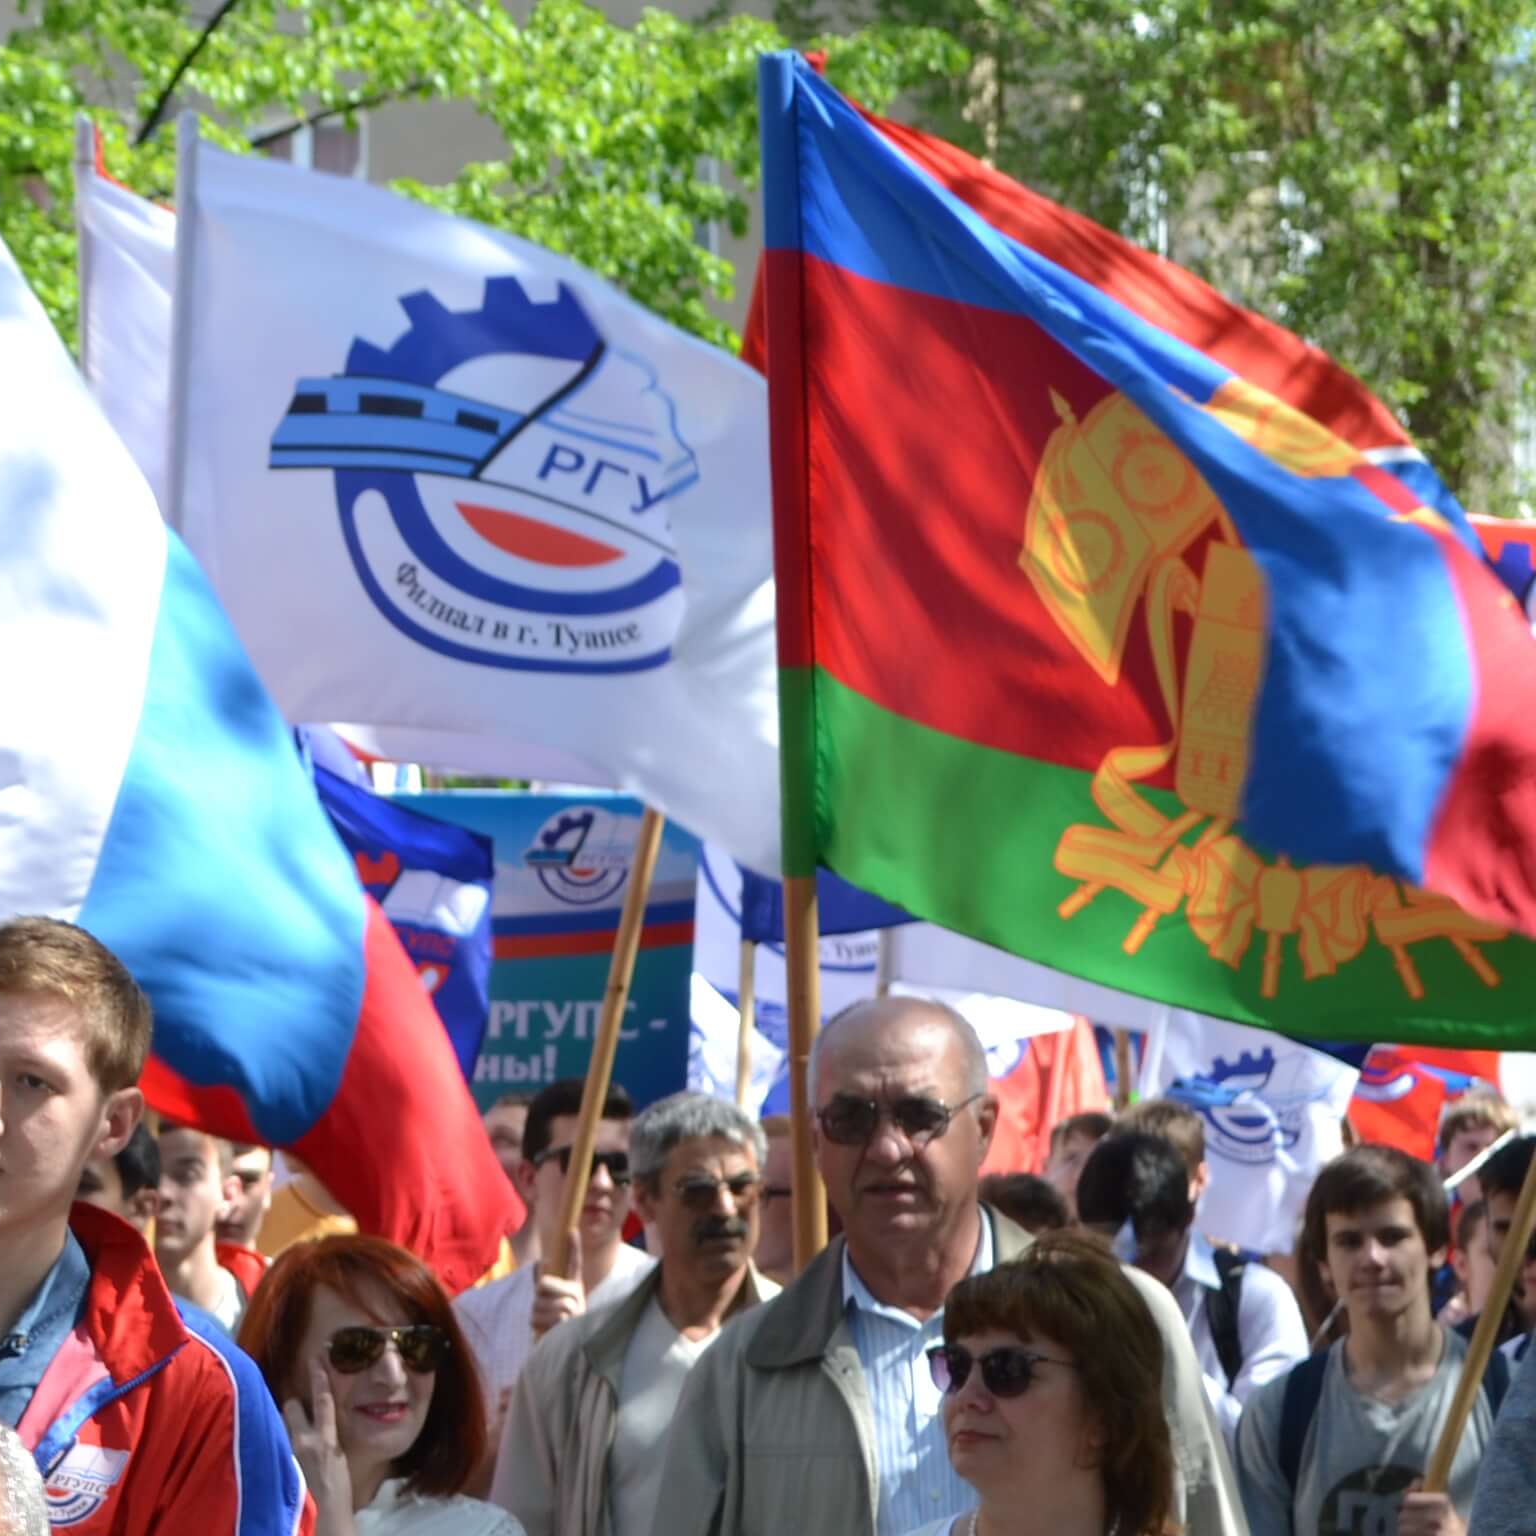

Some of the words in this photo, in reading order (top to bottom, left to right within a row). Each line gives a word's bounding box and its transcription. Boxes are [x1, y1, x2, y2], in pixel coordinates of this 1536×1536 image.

[396, 561, 486, 636] Филиал
[492, 621, 510, 640] в
[517, 625, 539, 645] г.
[546, 620, 641, 656] Туапсе
[473, 1043, 559, 1083] ны!
